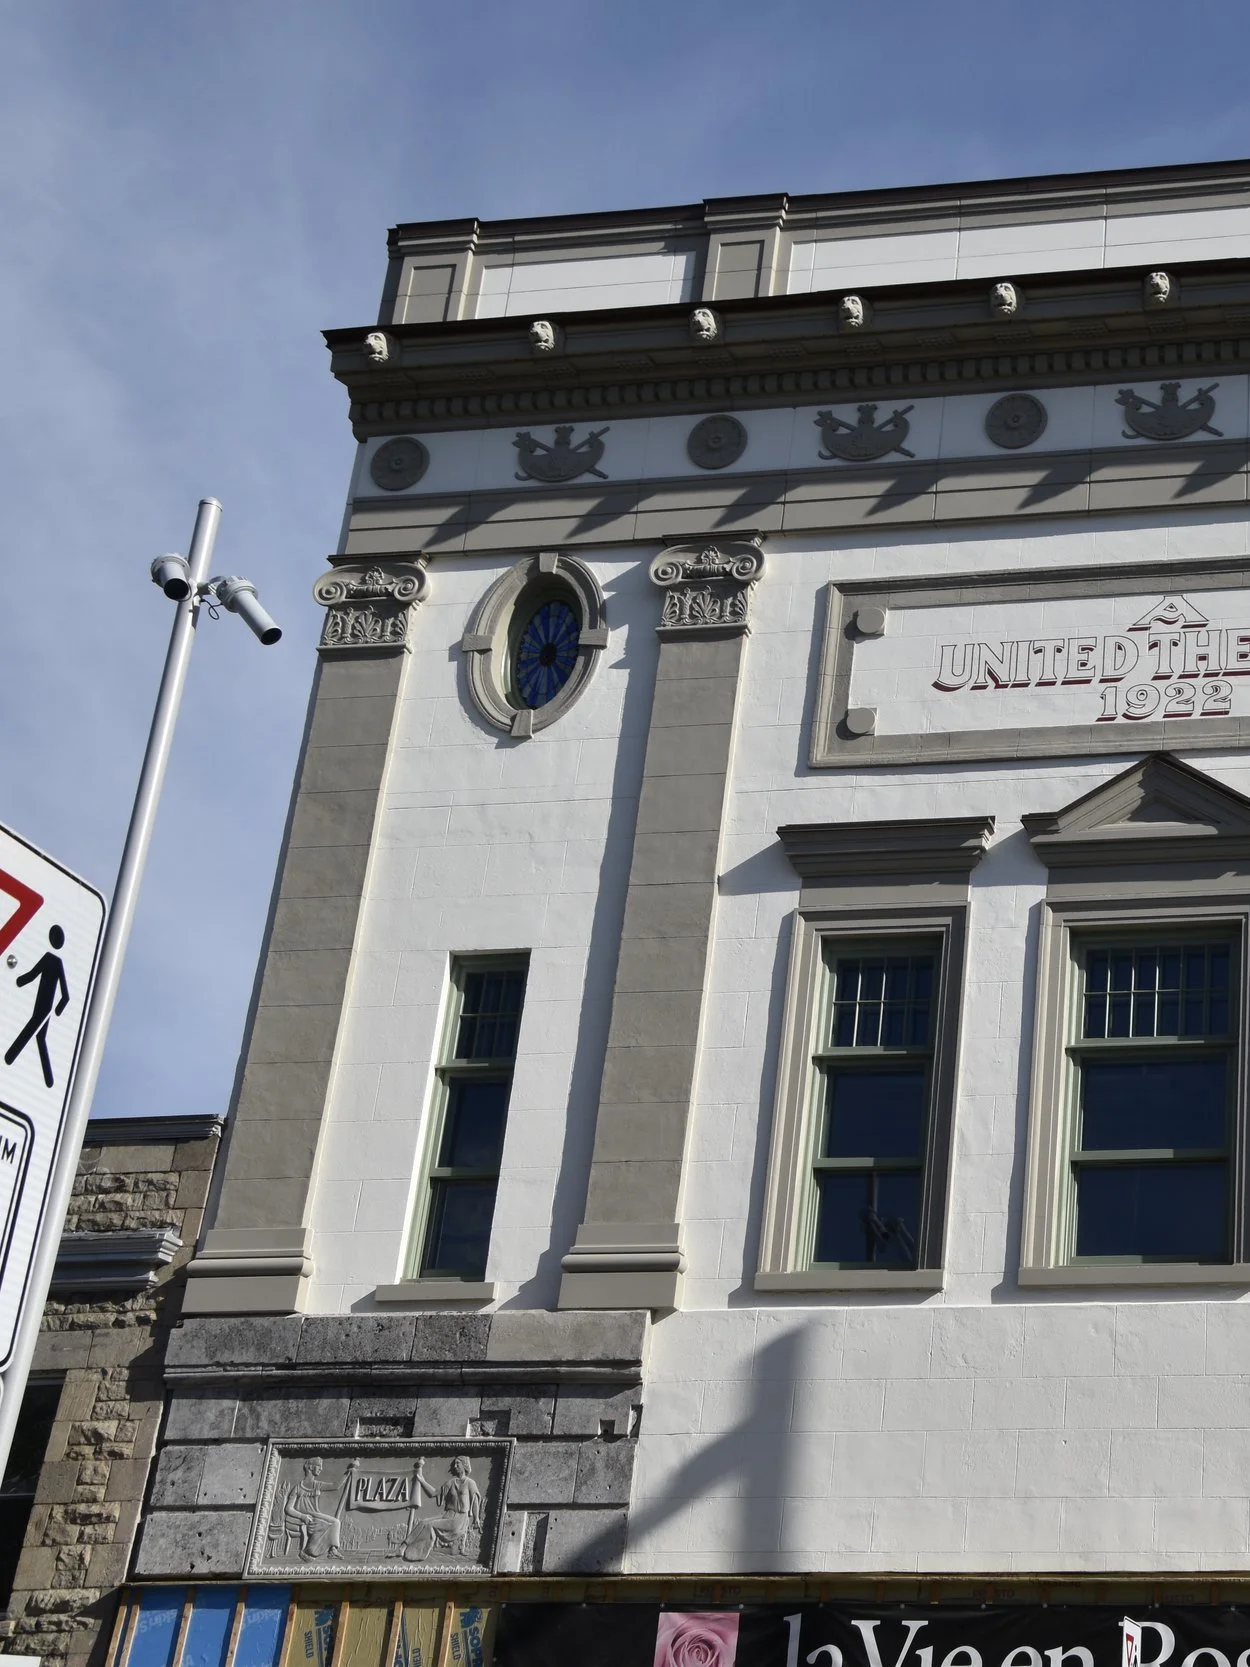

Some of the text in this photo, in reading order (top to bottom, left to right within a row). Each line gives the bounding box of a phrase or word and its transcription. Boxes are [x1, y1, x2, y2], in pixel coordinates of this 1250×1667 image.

[1127, 595, 1209, 631] A
[932, 634, 1139, 692] UNITED
[1096, 678, 1234, 722] 1922
[356, 1477, 408, 1502] PLAZA
